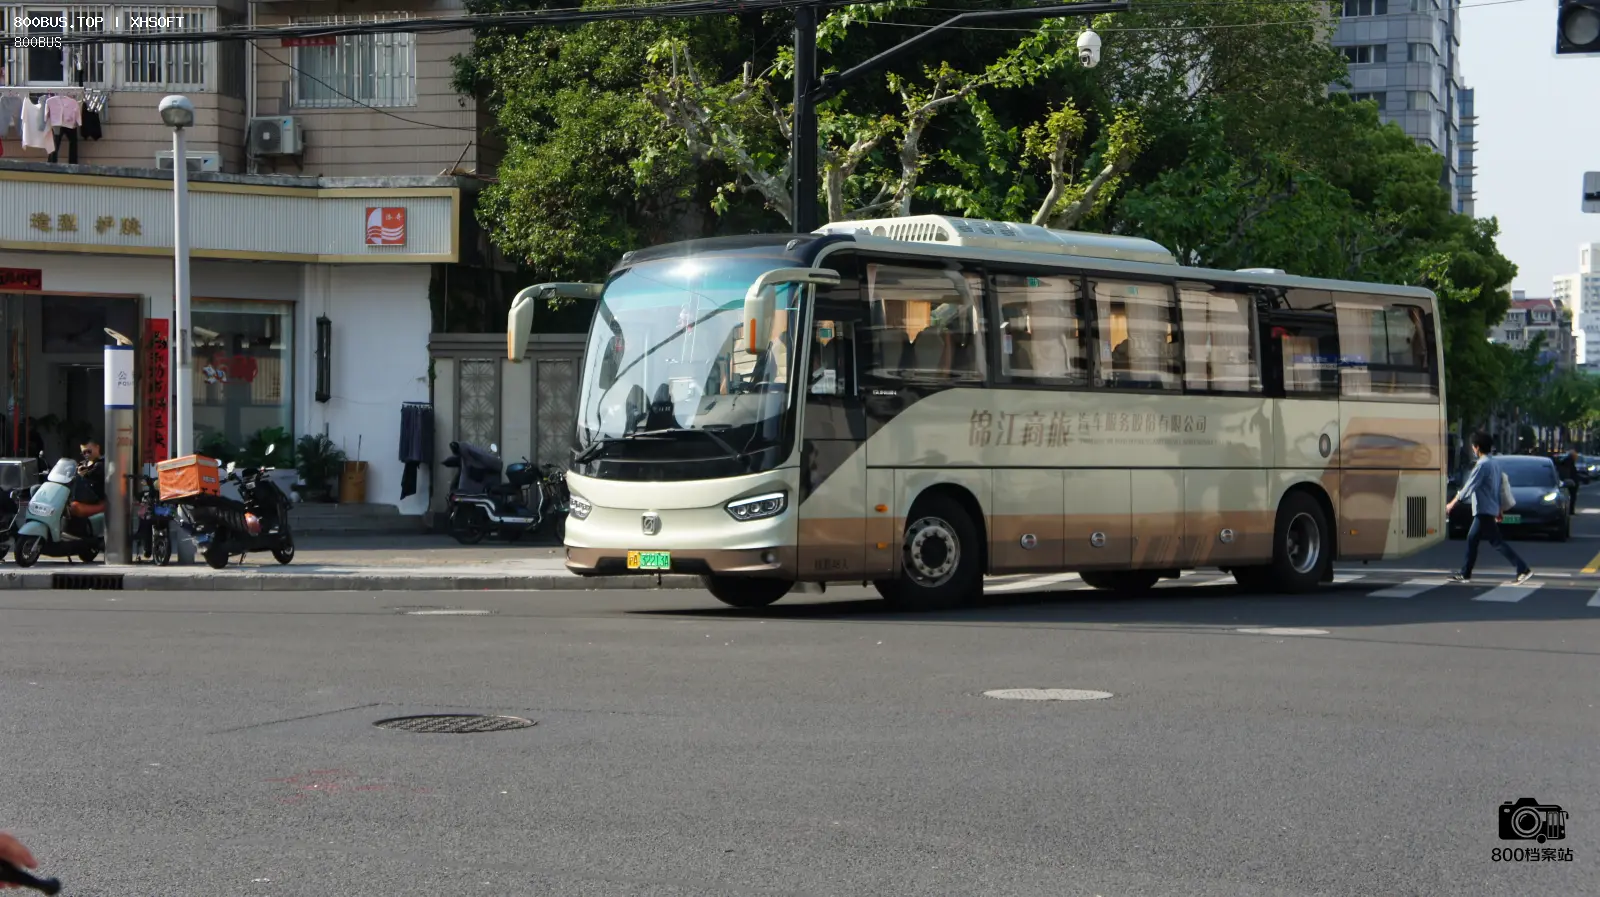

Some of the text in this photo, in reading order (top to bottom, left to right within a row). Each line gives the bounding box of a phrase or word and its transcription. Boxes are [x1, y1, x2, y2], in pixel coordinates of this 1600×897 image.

[968, 409, 1207, 448] 锦江商旅 汽车服务股份有限公司
